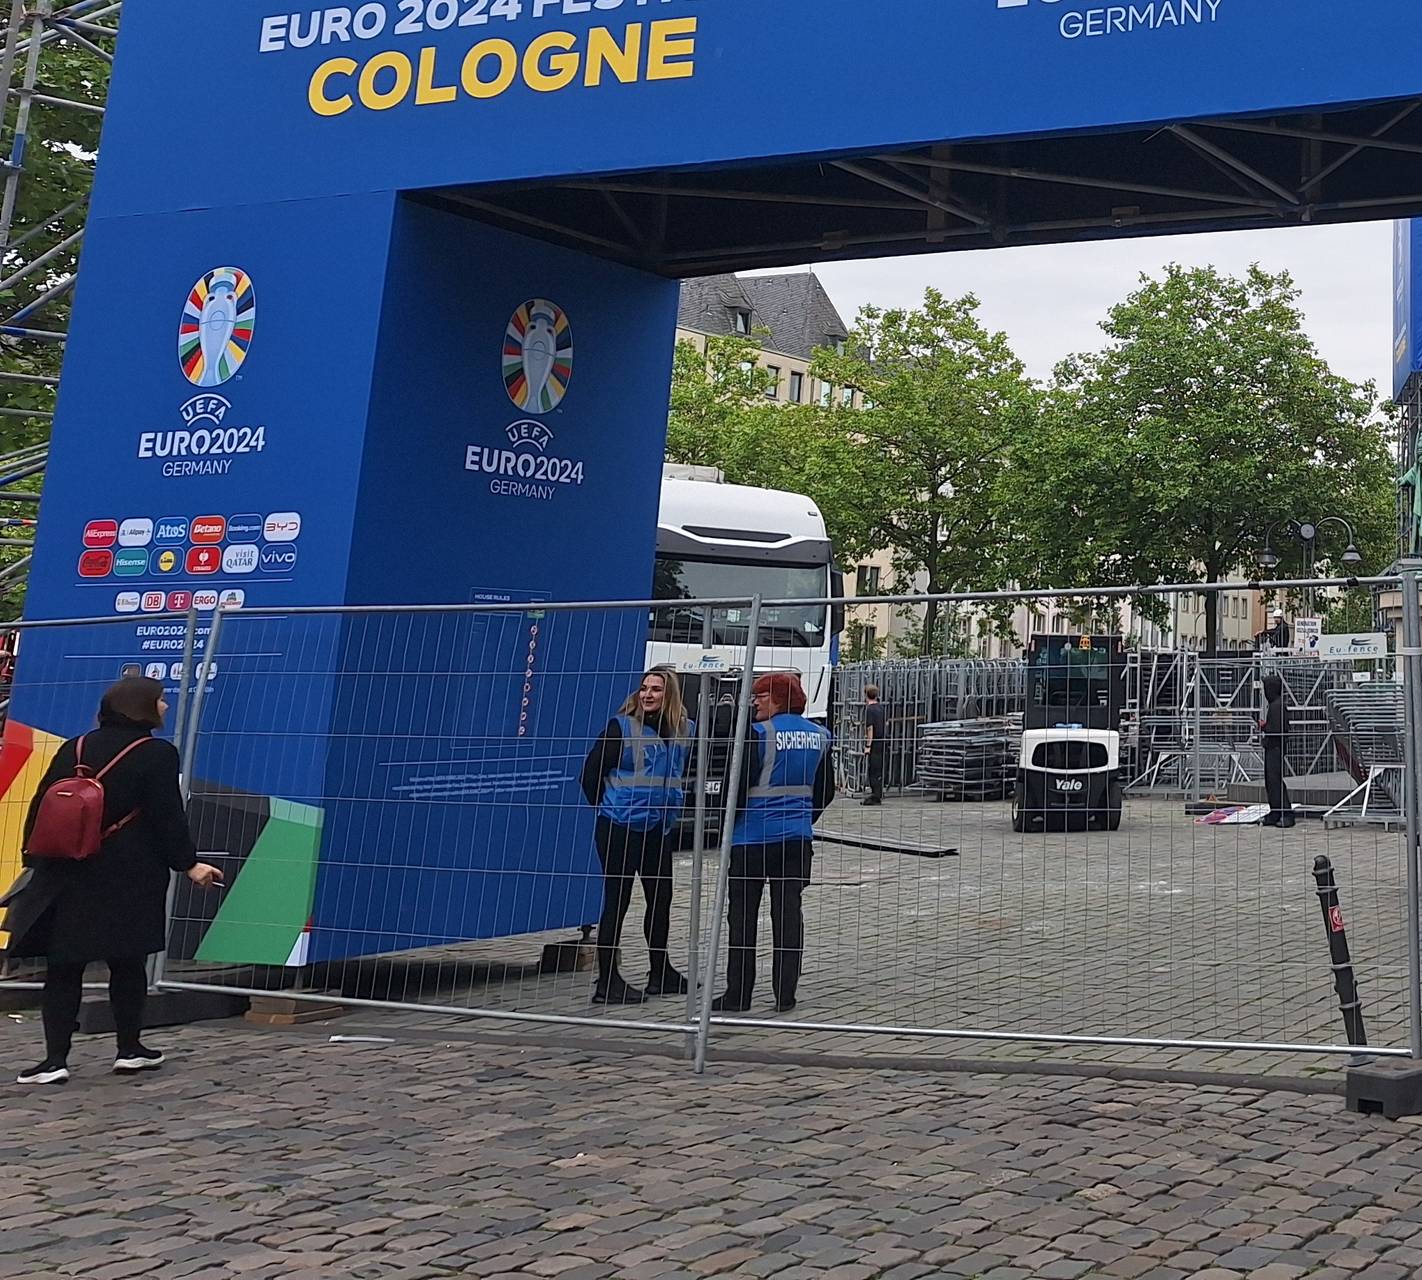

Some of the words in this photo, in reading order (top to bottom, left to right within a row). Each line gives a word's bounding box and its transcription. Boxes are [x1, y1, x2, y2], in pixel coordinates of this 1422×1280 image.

[259, 3, 387, 52] EURO
[395, 0, 522, 35] 2024
[1059, 0, 1222, 38] GERMANY
[307, 16, 698, 116] COLOGNE
[182, 399, 226, 421] UEFA
[138, 426, 266, 458] EURO2024
[507, 424, 550, 449] UEFA
[162, 459, 233, 477] GERMANY
[465, 445, 584, 485] EURO2024
[490, 479, 556, 500] GERMANY
[265, 522, 299, 532] BYD
[116, 558, 146, 567] Hisense
[226, 558, 253, 569] QATAR
[235, 550, 255, 558] visit
[261, 551, 296, 563] vivo
[194, 595, 216, 605] ERGO
[1055, 778, 1083, 791] Yale
